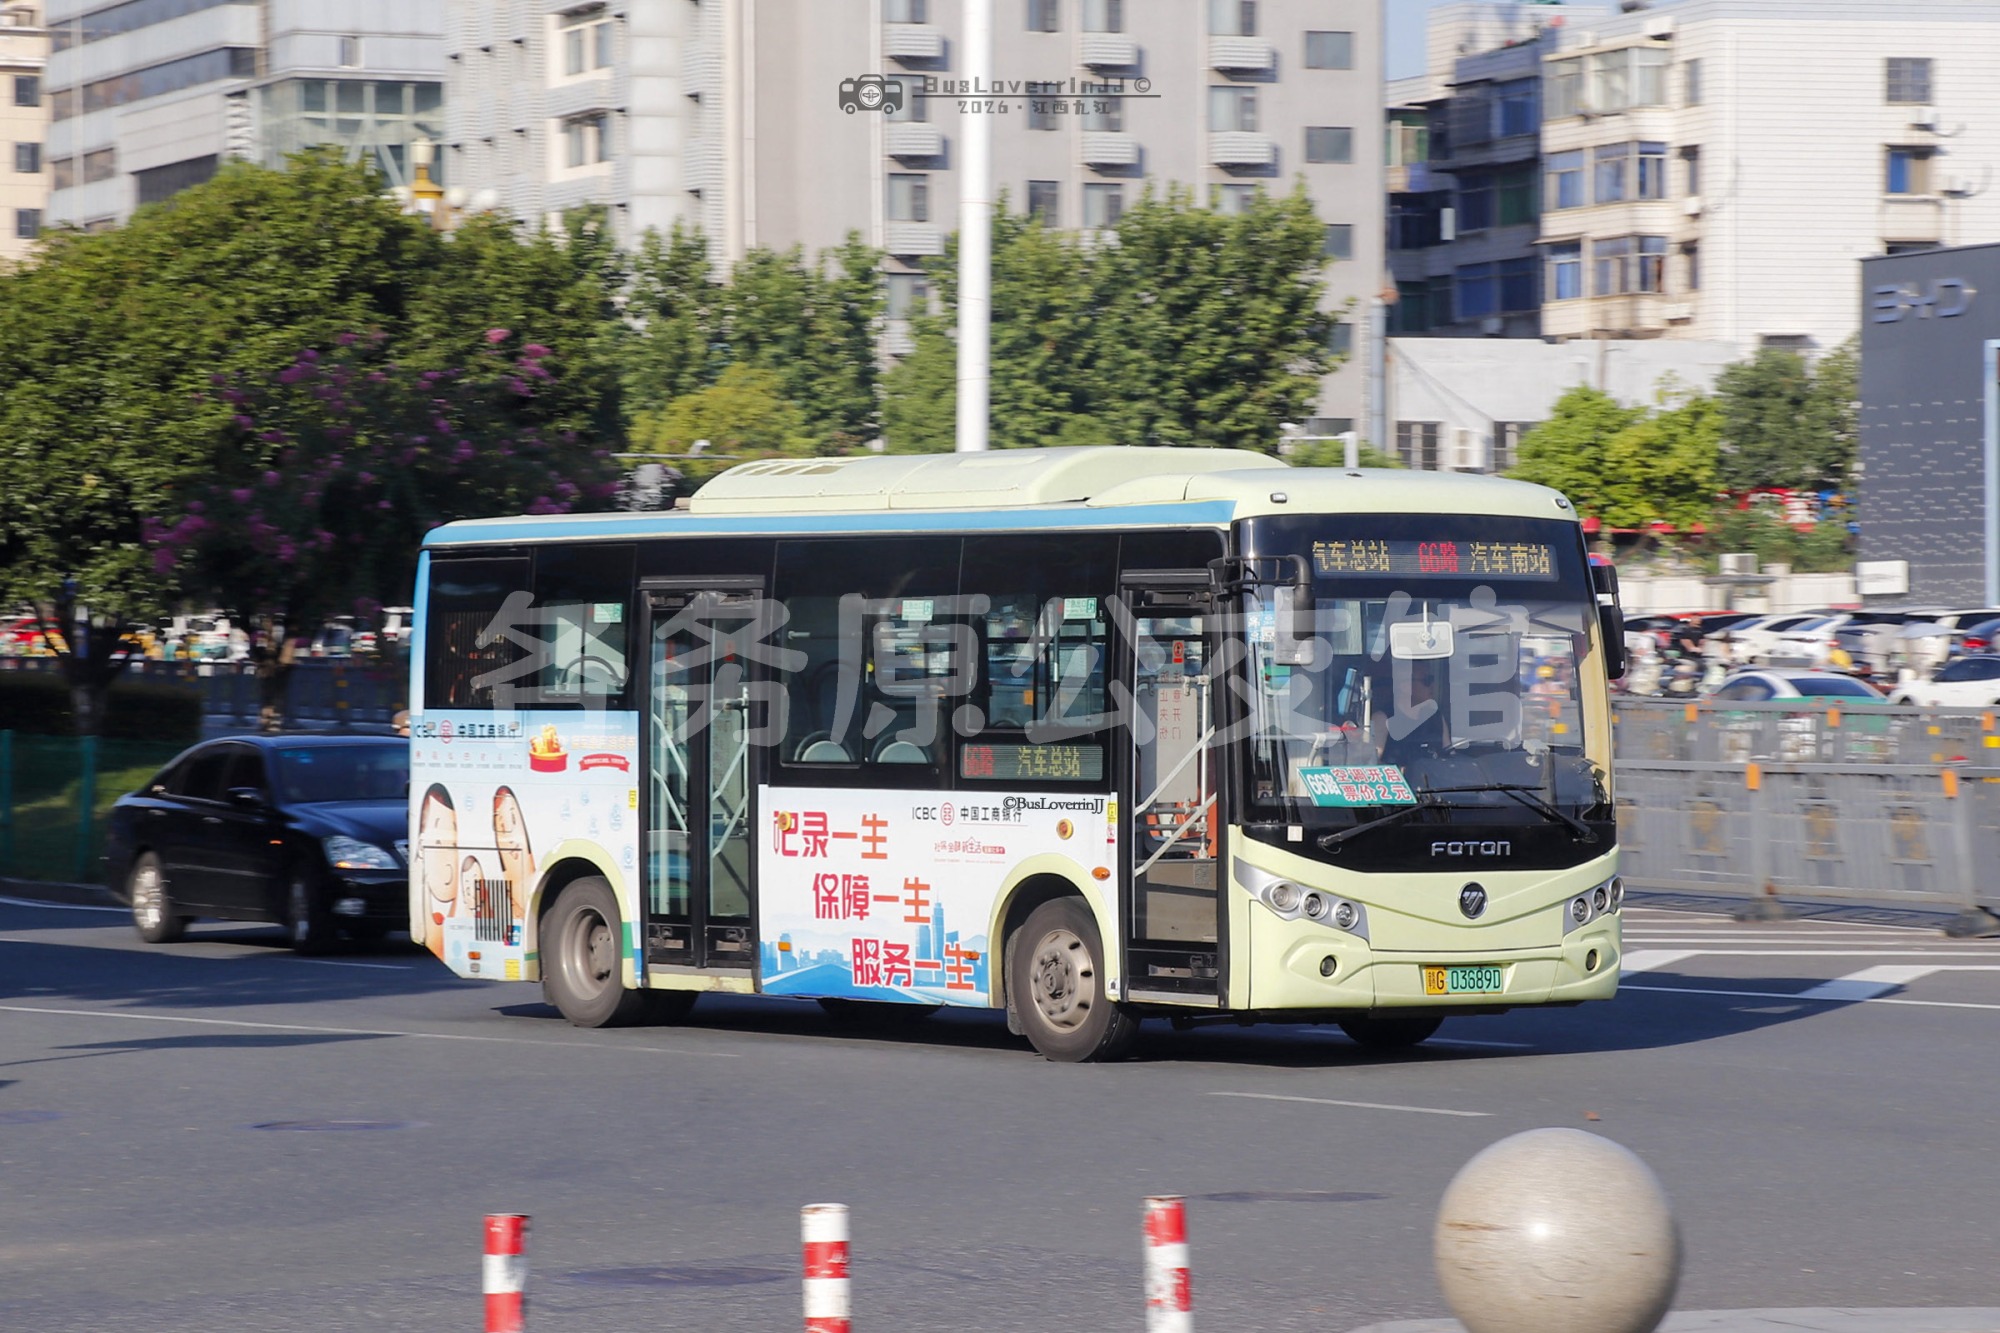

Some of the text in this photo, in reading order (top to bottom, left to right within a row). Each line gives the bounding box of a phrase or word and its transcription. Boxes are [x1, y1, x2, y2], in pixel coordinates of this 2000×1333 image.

[1872, 277, 1972, 323] BYD
[1418, 541, 1459, 573] 66路
[1469, 542, 1551, 574] 汽车南站
[1017, 745, 1081, 777] 汽车总站
[1306, 773, 1342, 796] 66路
[1331, 767, 1405, 783] 空调开启
[1340, 783, 1412, 802] 票价2元
[912, 806, 937, 820] ICBC
[960, 806, 1022, 823] 中国工商银行
[773, 810, 888, 859] 记录一生
[1431, 841, 1511, 856] FOTON
[812, 872, 931, 923] 保障一生
[852, 938, 975, 990] 服务一生
